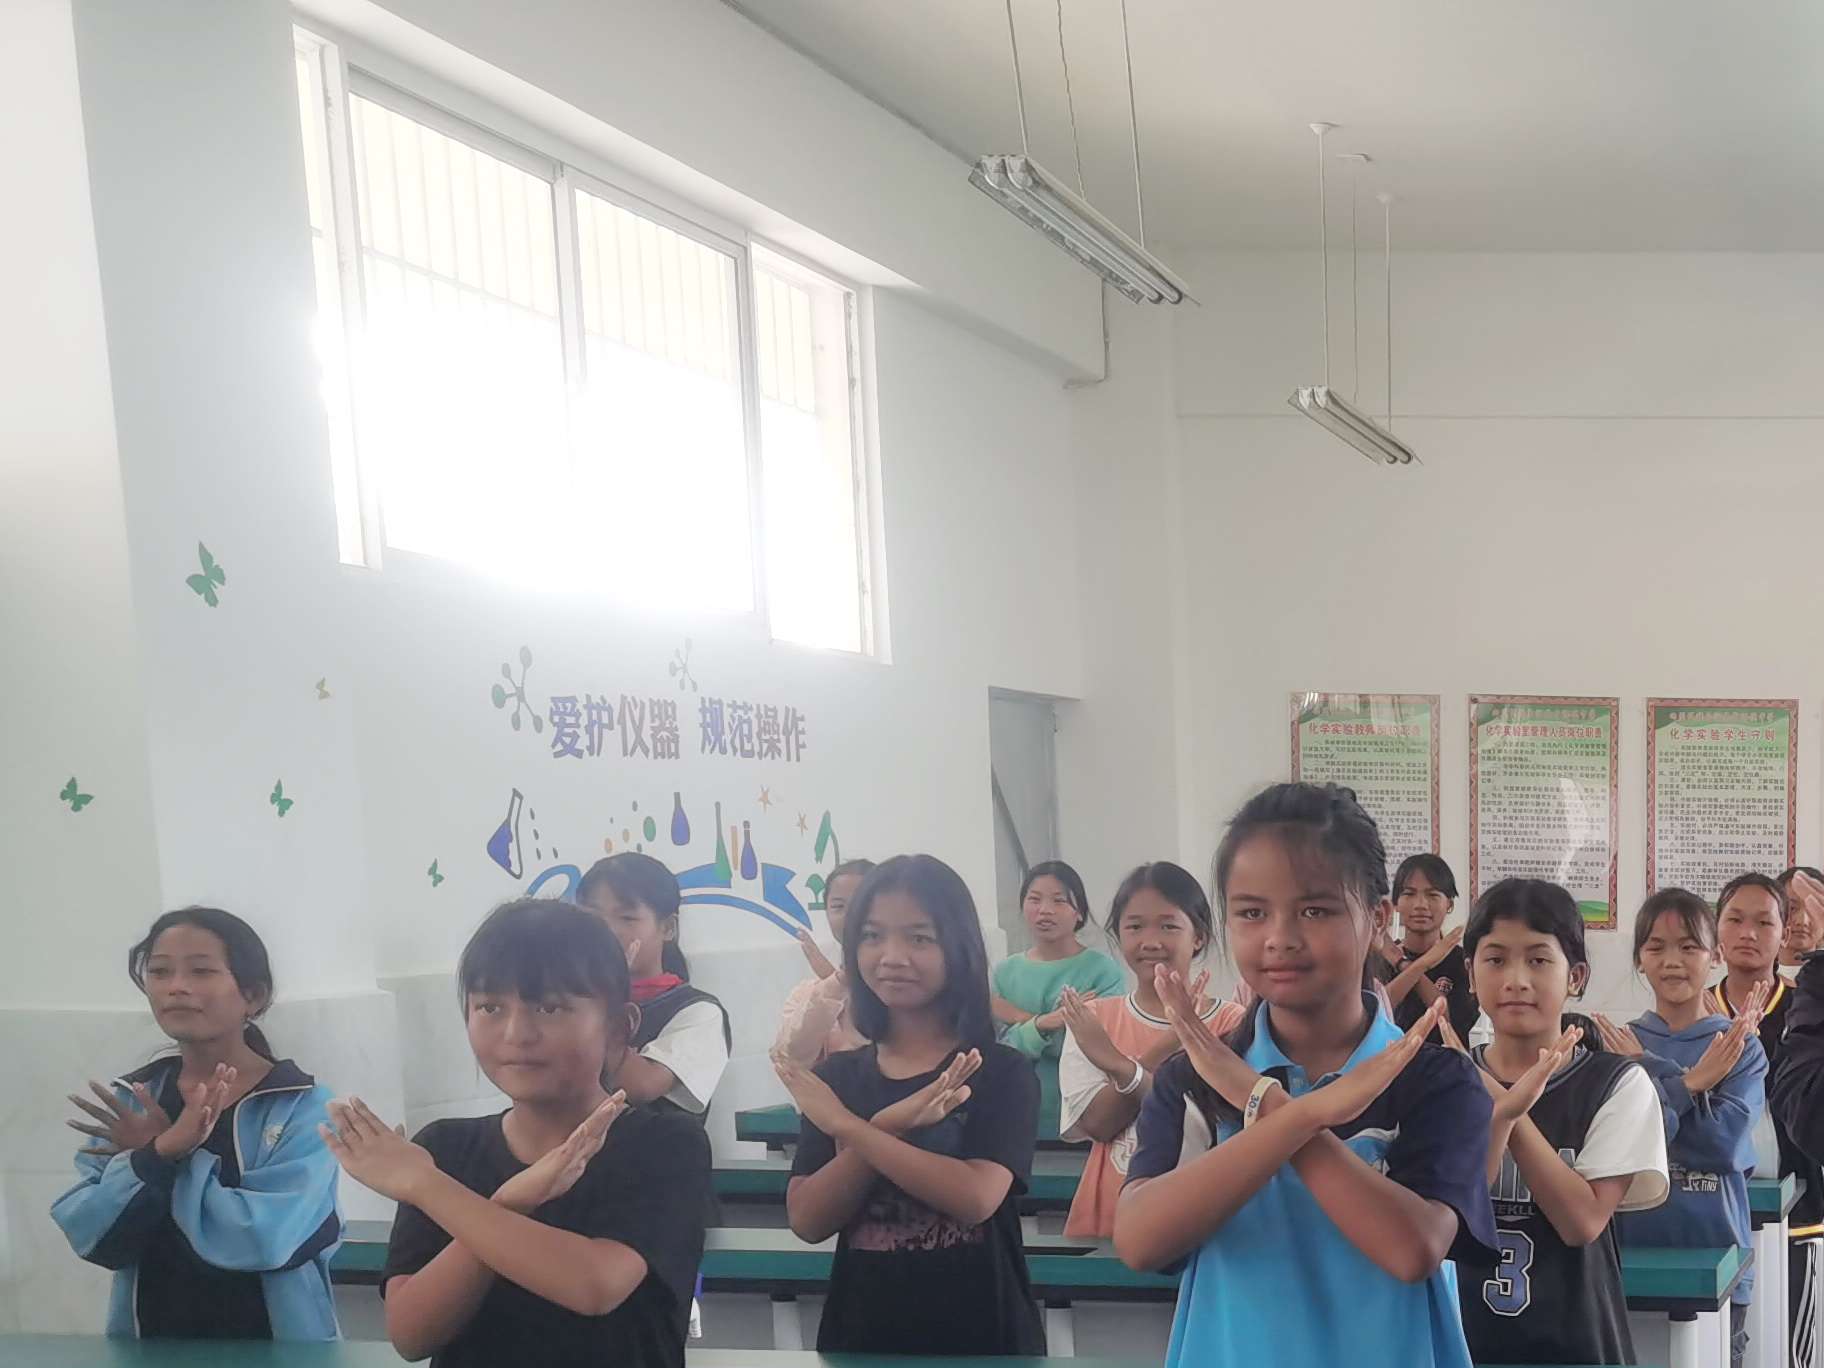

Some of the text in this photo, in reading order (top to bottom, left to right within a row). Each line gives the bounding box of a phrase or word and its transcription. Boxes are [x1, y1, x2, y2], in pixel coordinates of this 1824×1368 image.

[550, 694, 807, 763] 爱护仪器 规范操作
[1670, 727, 1776, 742] 化学实验学生守则
[1483, 1228, 1535, 1317] 3
